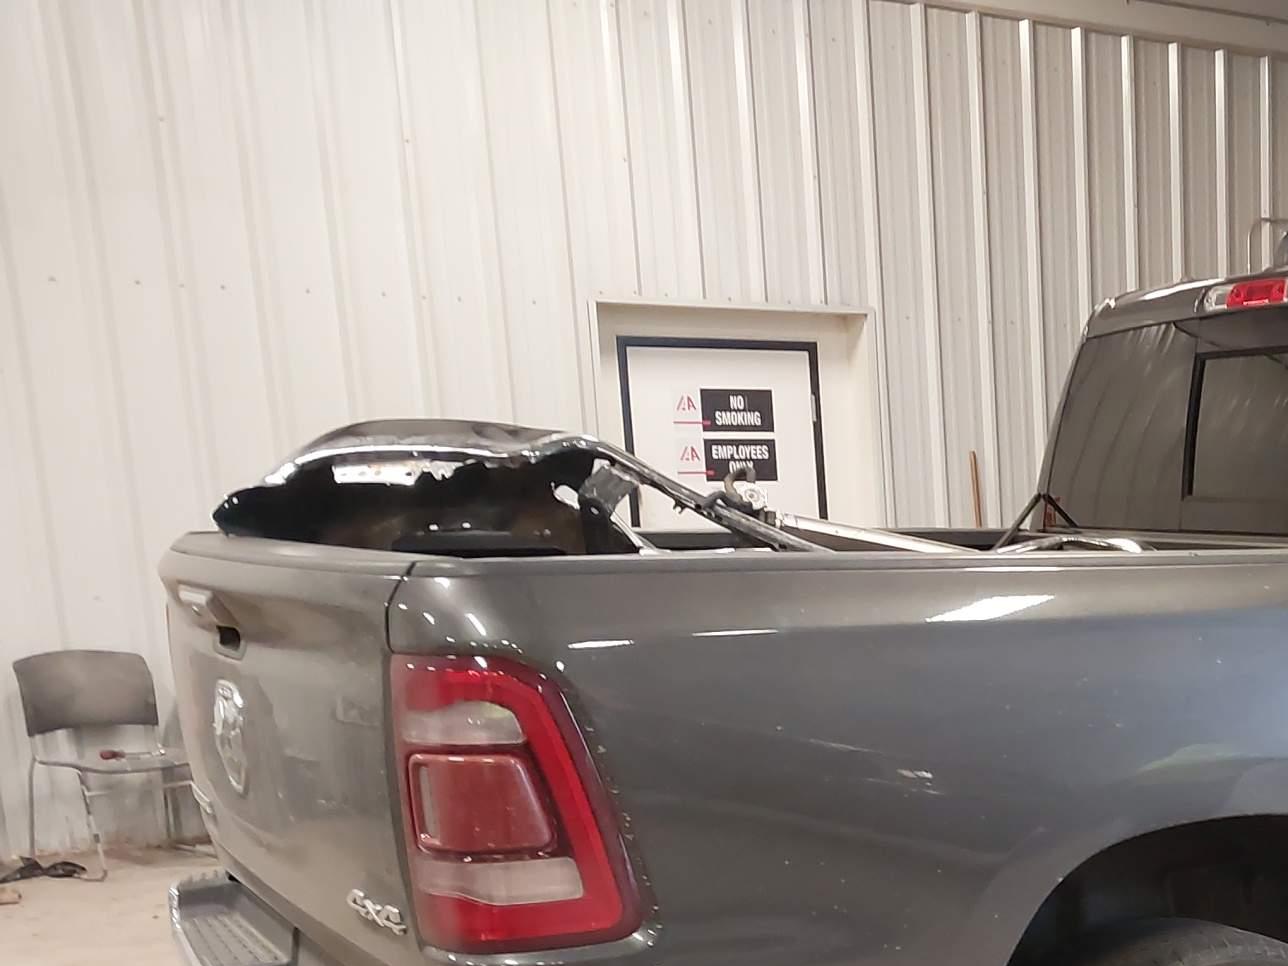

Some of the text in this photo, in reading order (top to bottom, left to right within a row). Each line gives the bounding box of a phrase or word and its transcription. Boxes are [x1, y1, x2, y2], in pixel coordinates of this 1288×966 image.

[729, 395, 745, 410] NO
[715, 411, 761, 426] SMOKING
[711, 445, 769, 459] EMPLOYEES
